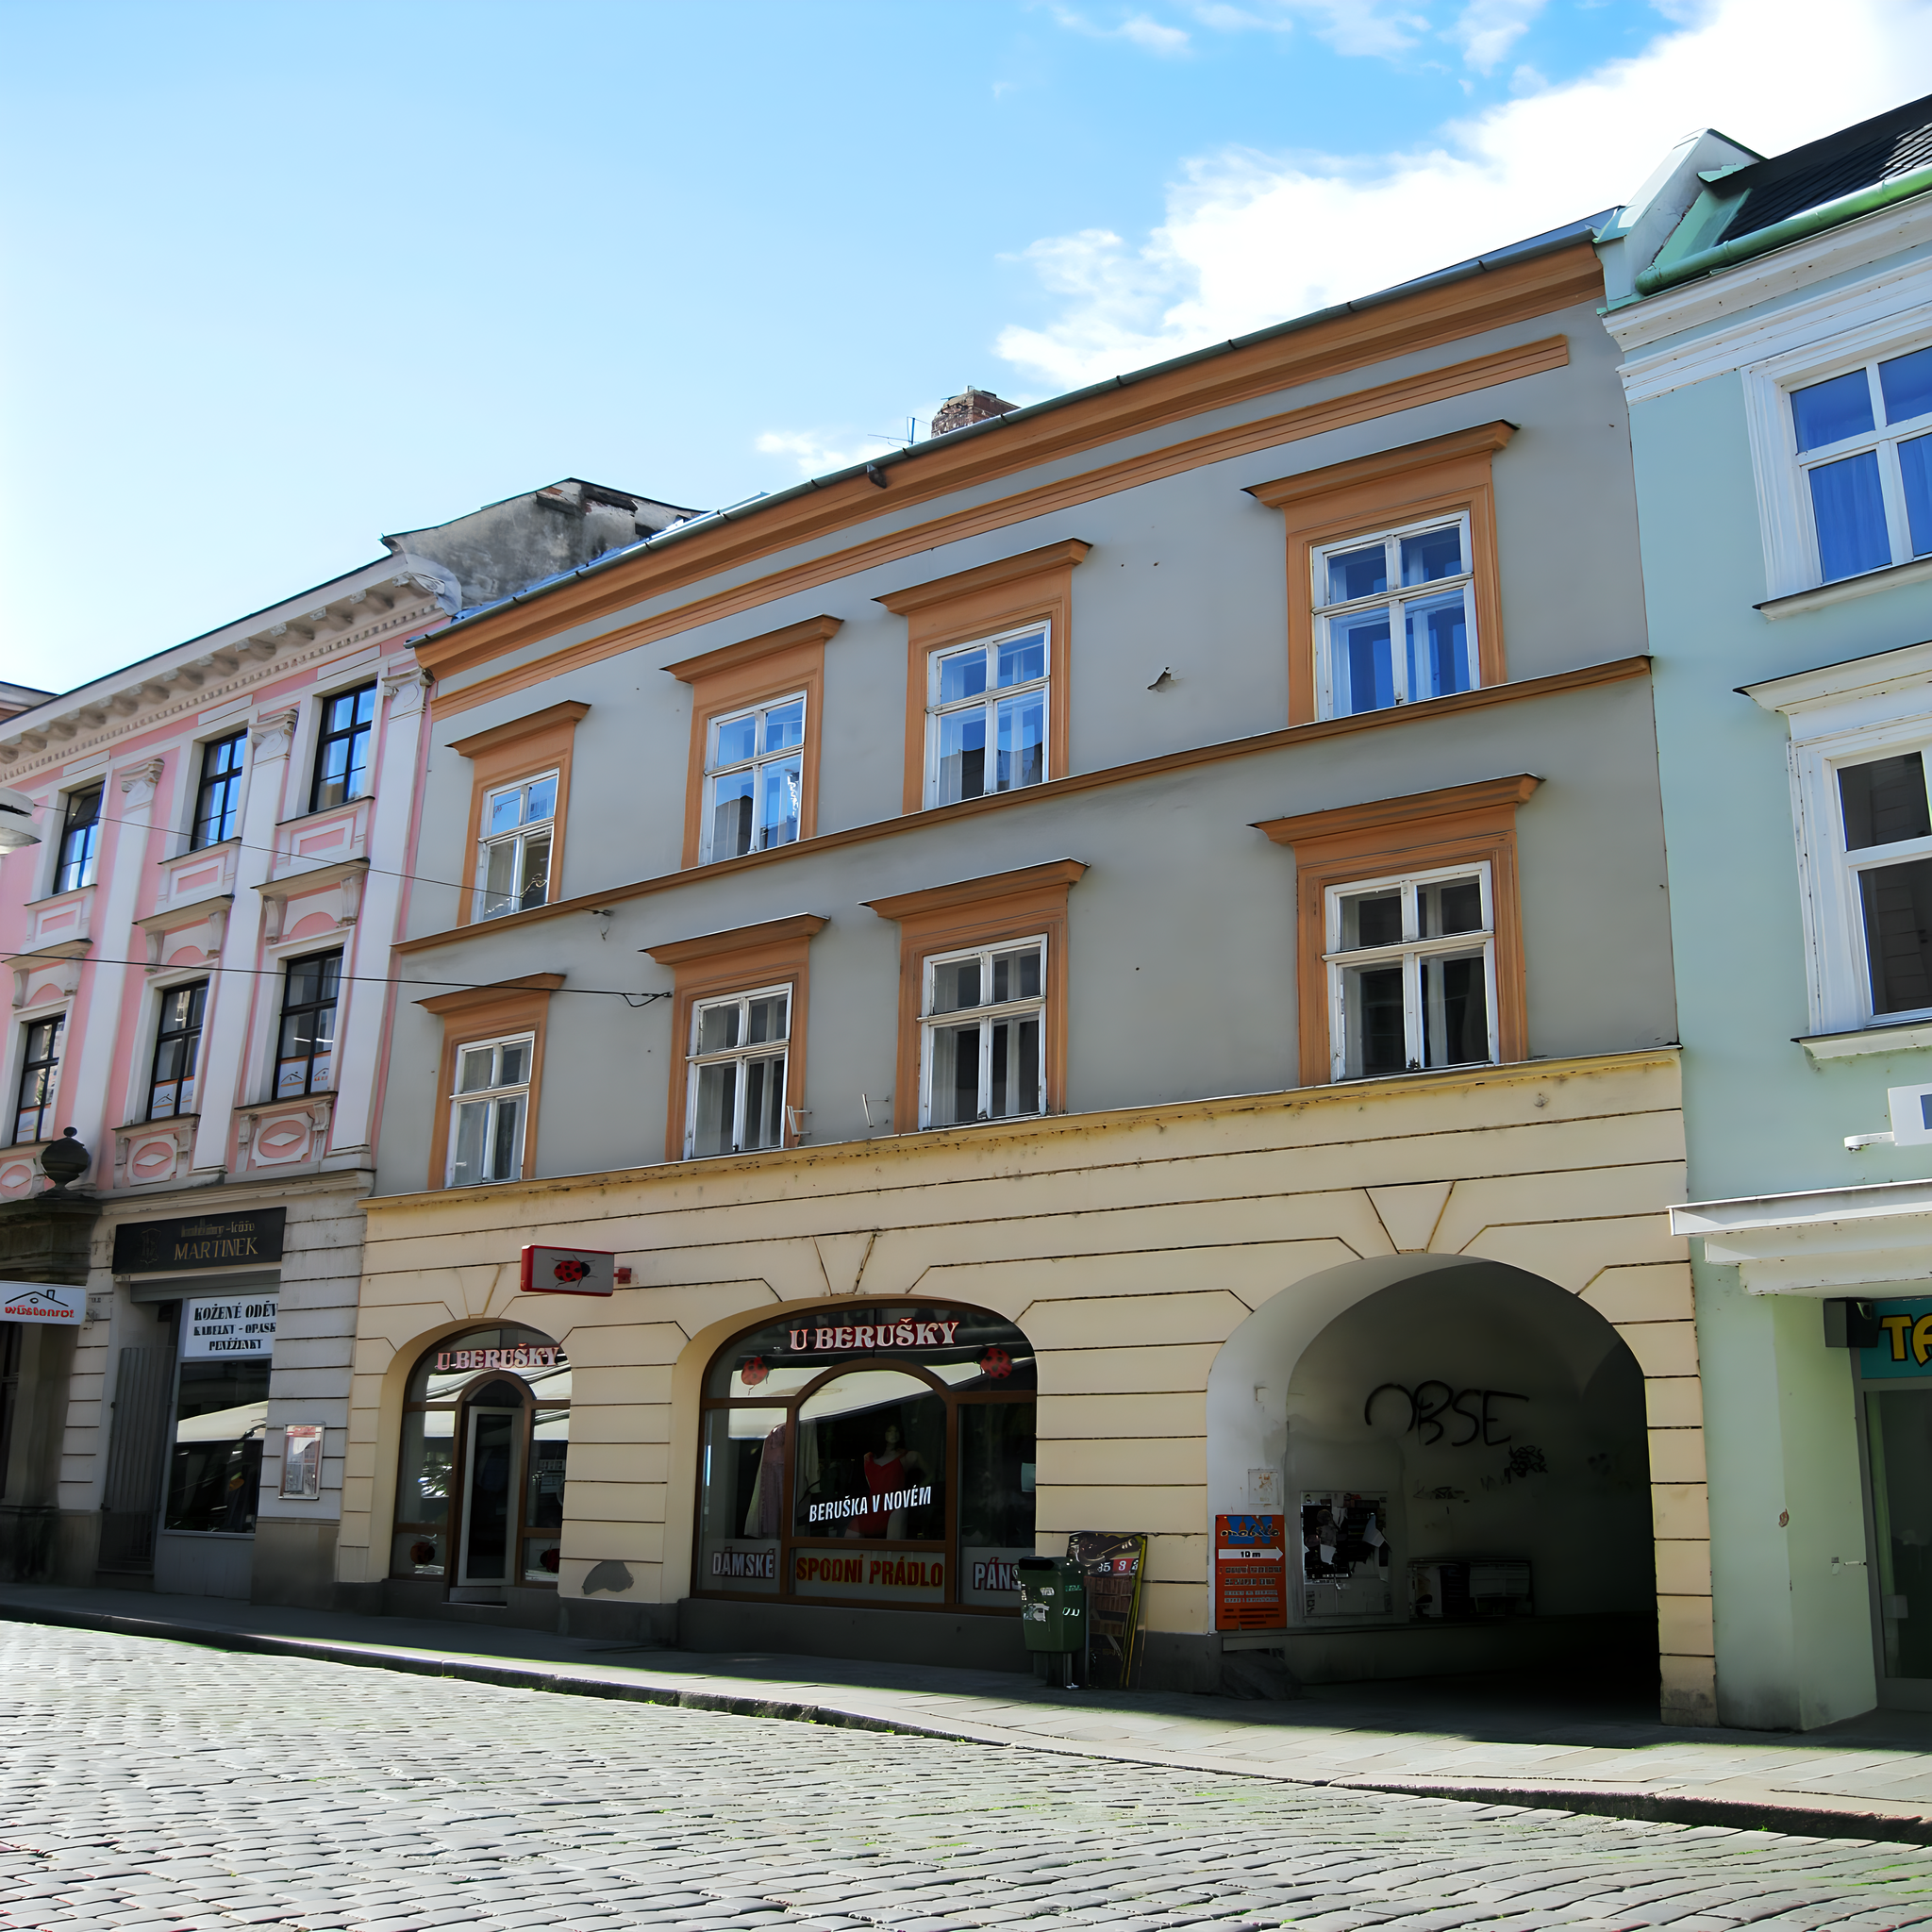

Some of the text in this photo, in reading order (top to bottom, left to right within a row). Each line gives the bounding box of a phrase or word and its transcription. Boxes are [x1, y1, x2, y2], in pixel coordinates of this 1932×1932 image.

[174, 1237, 258, 1260] MARTINEK
[194, 1302, 242, 1321] KOŽENÉ
[789, 1318, 959, 1350] U BERUŠKY
[435, 1343, 559, 1371] U BERUŠKY
[809, 1485, 932, 1523] BERUŠKA V NOVÉM
[711, 1547, 774, 1578] DÁMSKÉ
[795, 1554, 943, 1587] SPODNÍ PRÁDLO
